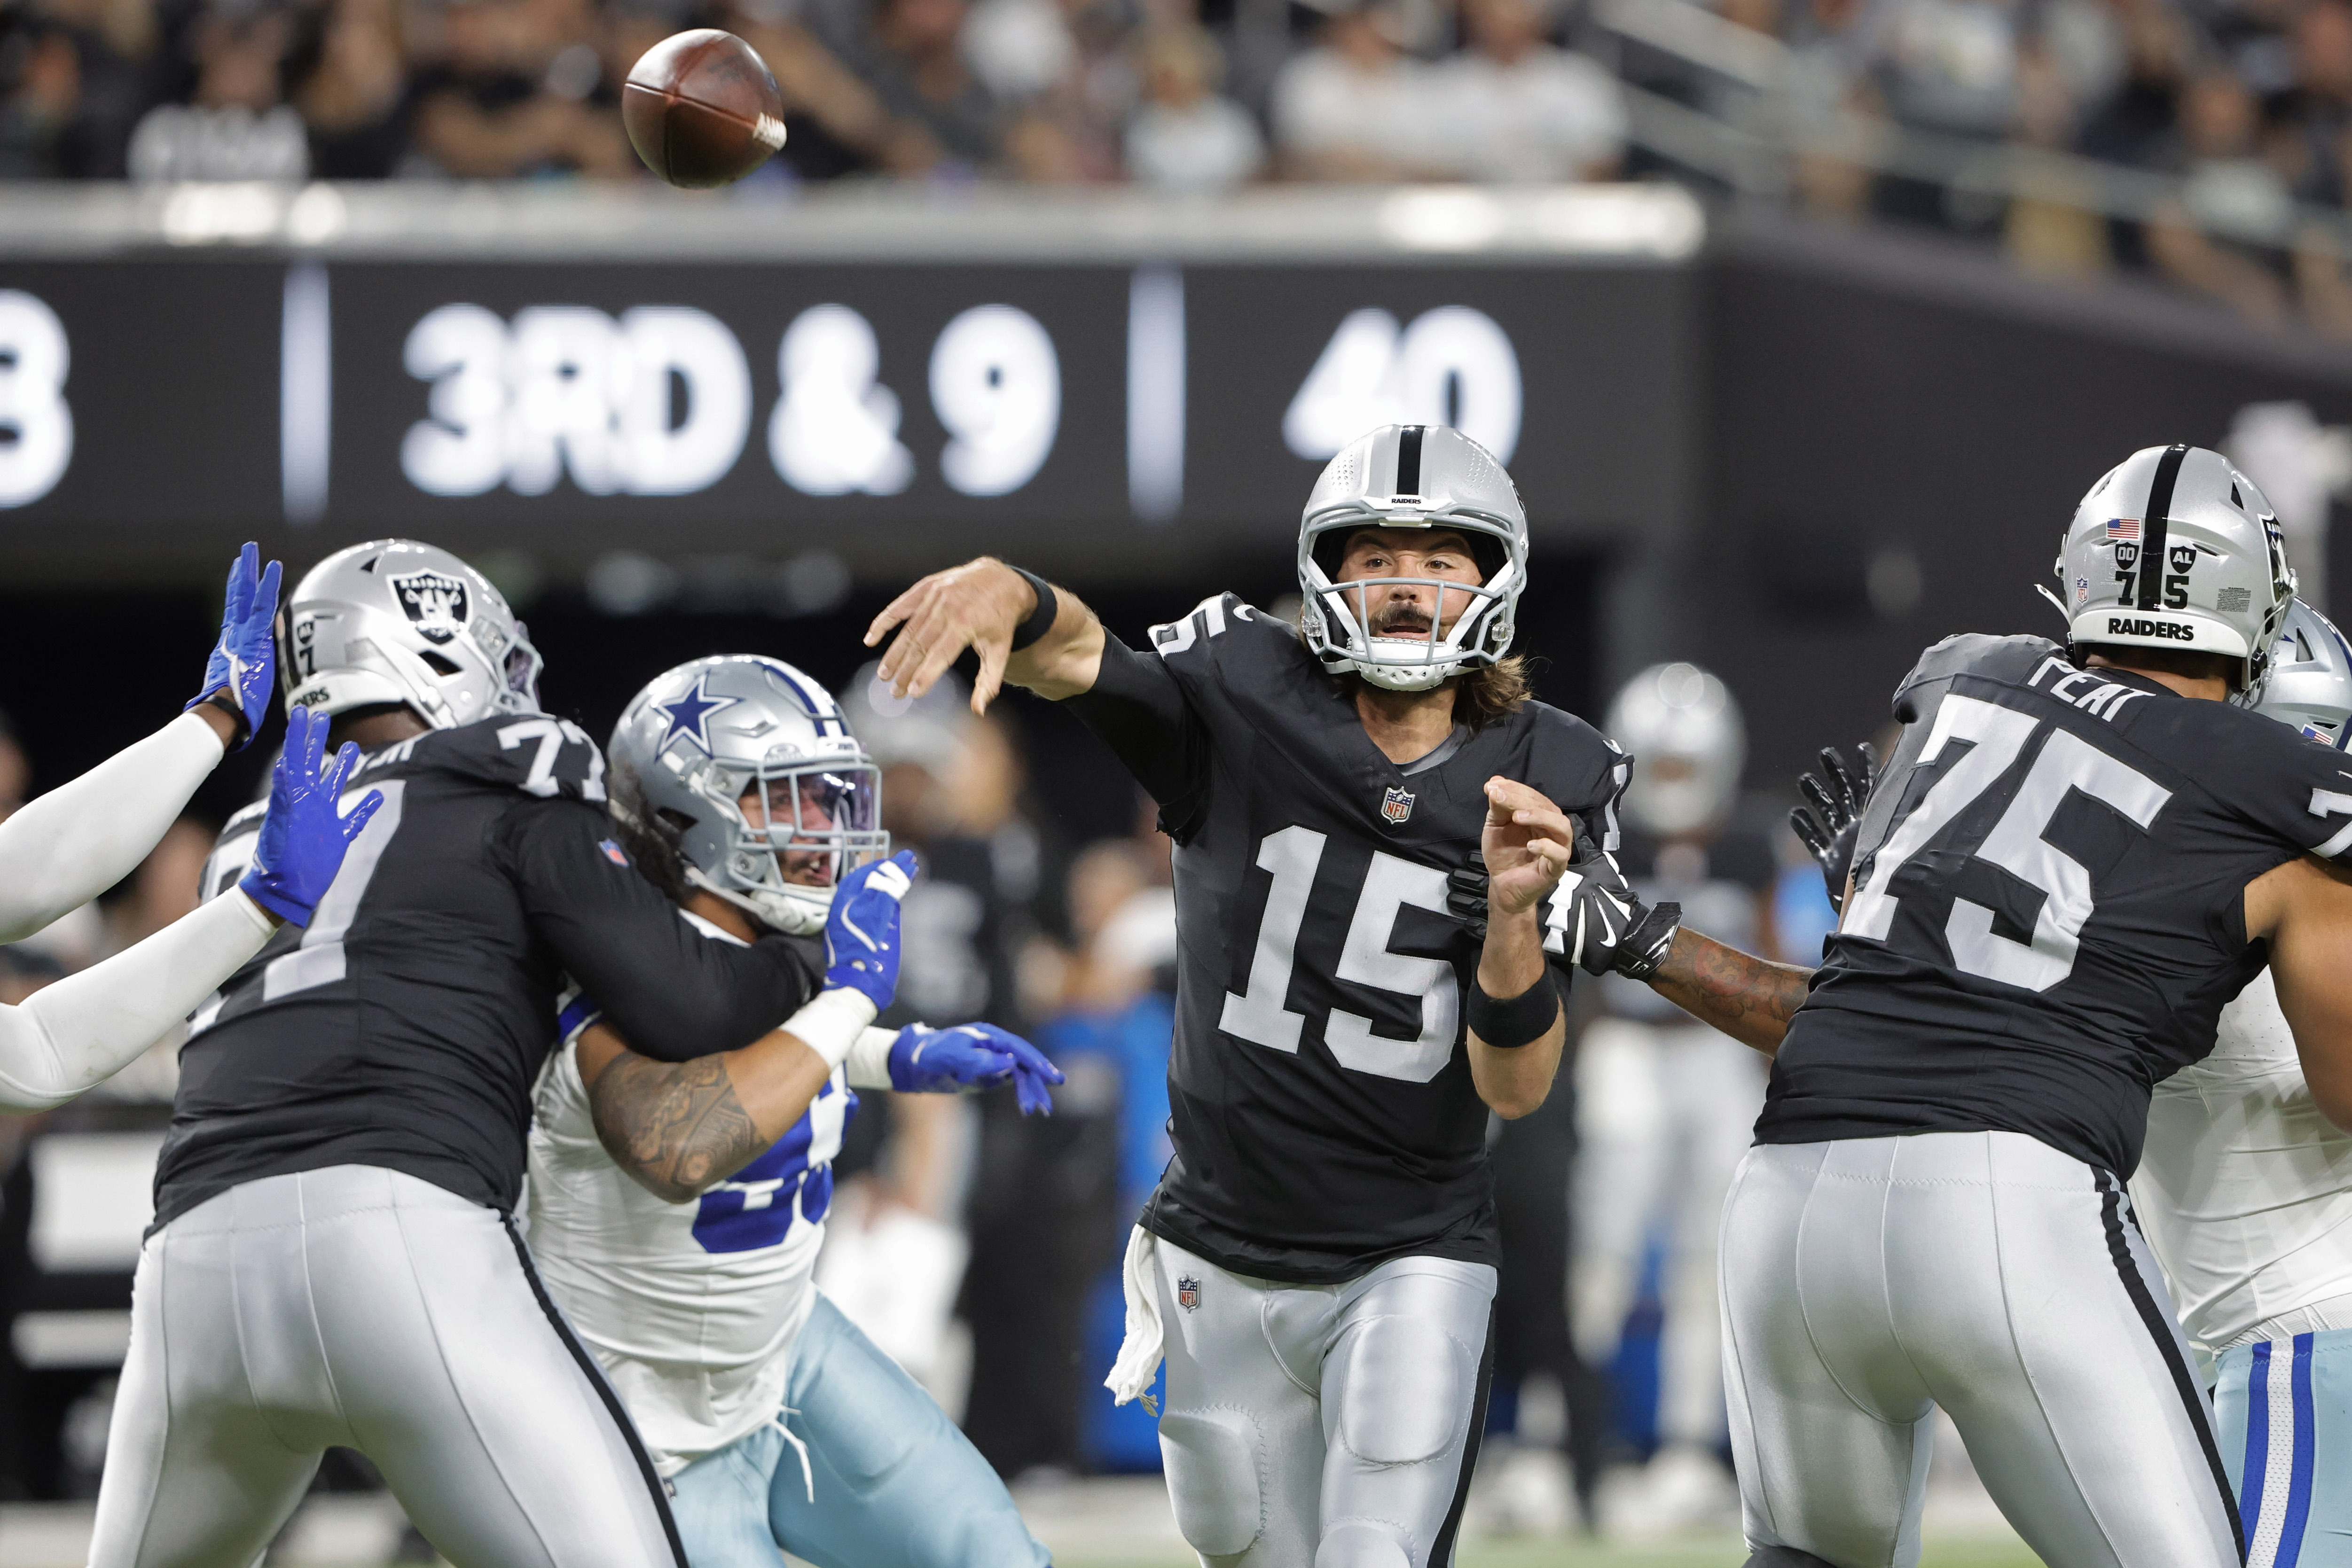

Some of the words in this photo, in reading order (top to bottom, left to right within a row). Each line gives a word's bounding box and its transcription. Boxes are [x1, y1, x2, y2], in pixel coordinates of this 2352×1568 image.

[400, 302, 752, 496] 3RD
[768, 303, 916, 497] &
[928, 303, 1062, 497] 9
[1283, 305, 1523, 469] 40
[2117, 546, 2135, 561] 00
[2172, 551, 2192, 564] AL
[399, 577, 461, 592] RAIDERS
[2115, 571, 2137, 606] 7
[2164, 575, 2189, 609] 5
[2109, 618, 2194, 641] RAIDERS
[2027, 657, 2156, 722] PEAT
[496, 719, 607, 802] 77
[1386, 802, 1405, 818] NFL
[1842, 694, 2173, 992] 75
[1218, 825, 1467, 1083] 15
[1181, 1292, 1196, 1305] NFL
